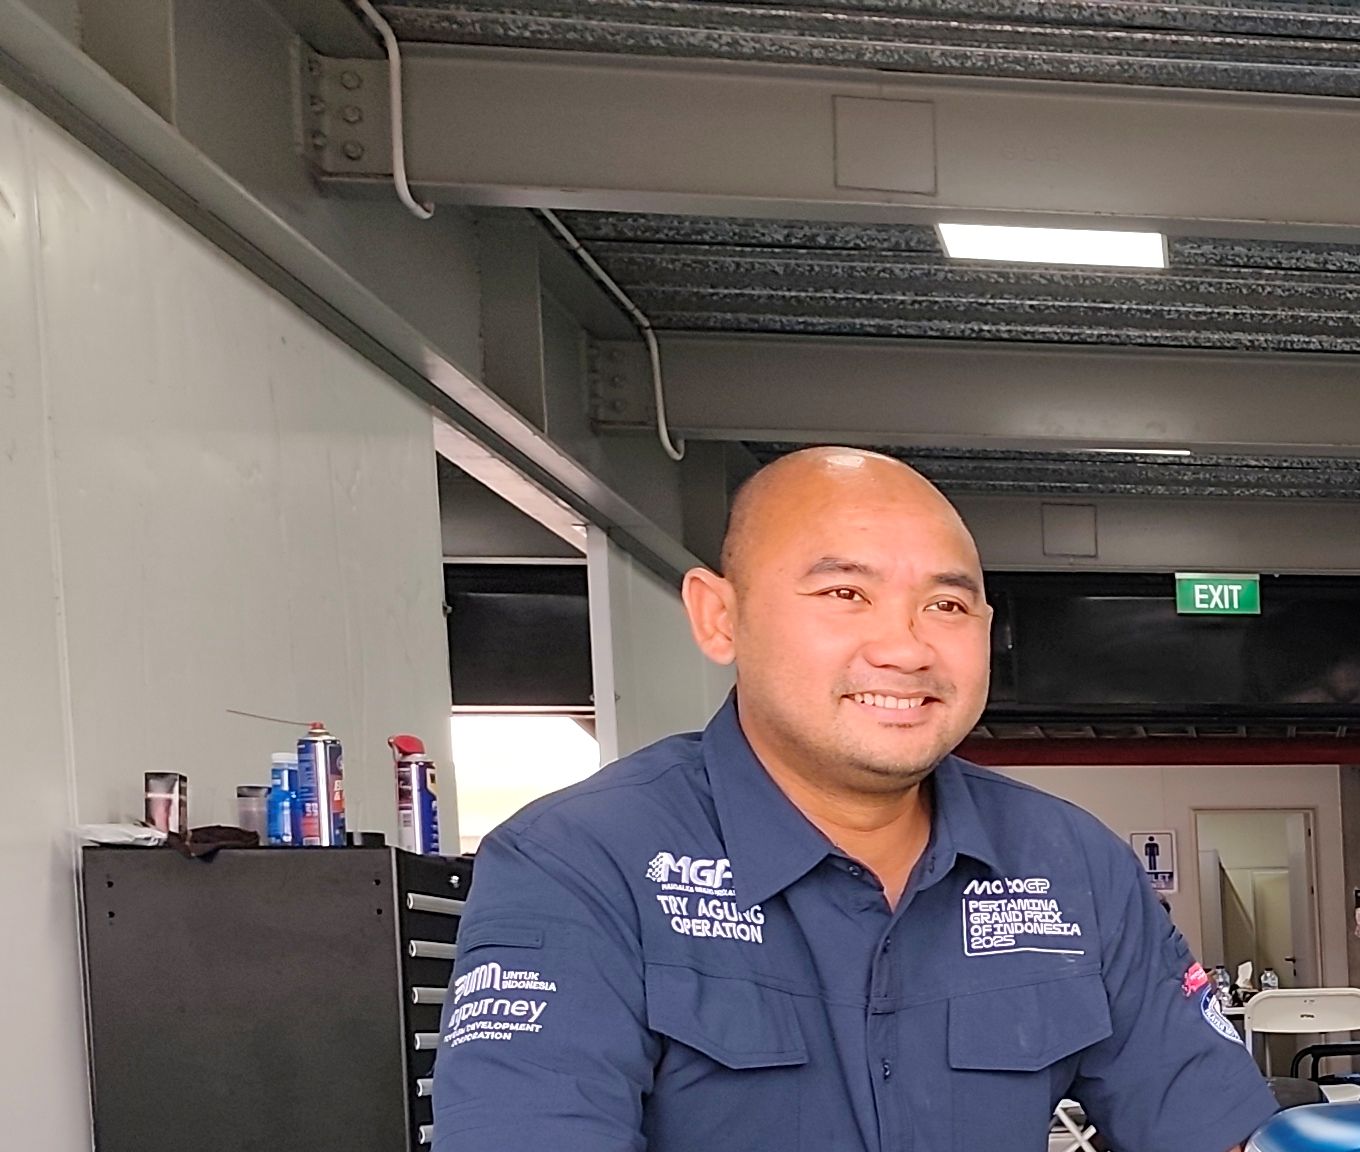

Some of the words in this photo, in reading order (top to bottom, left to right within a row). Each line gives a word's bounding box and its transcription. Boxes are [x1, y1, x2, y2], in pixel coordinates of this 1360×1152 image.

[1194, 584, 1242, 609] EXIT
[656, 895, 689, 915] TRY
[968, 899, 1059, 912] PERTAMINA
[969, 910, 1023, 924] GRAND
[1024, 910, 1063, 924] PRIX
[671, 916, 763, 943] OPERATION
[970, 924, 993, 937] OF
[993, 922, 1082, 936] INDONESIA
[970, 935, 1016, 949] 2025
[502, 970, 540, 981] UNTUK
[502, 979, 557, 992] INDONESIA
